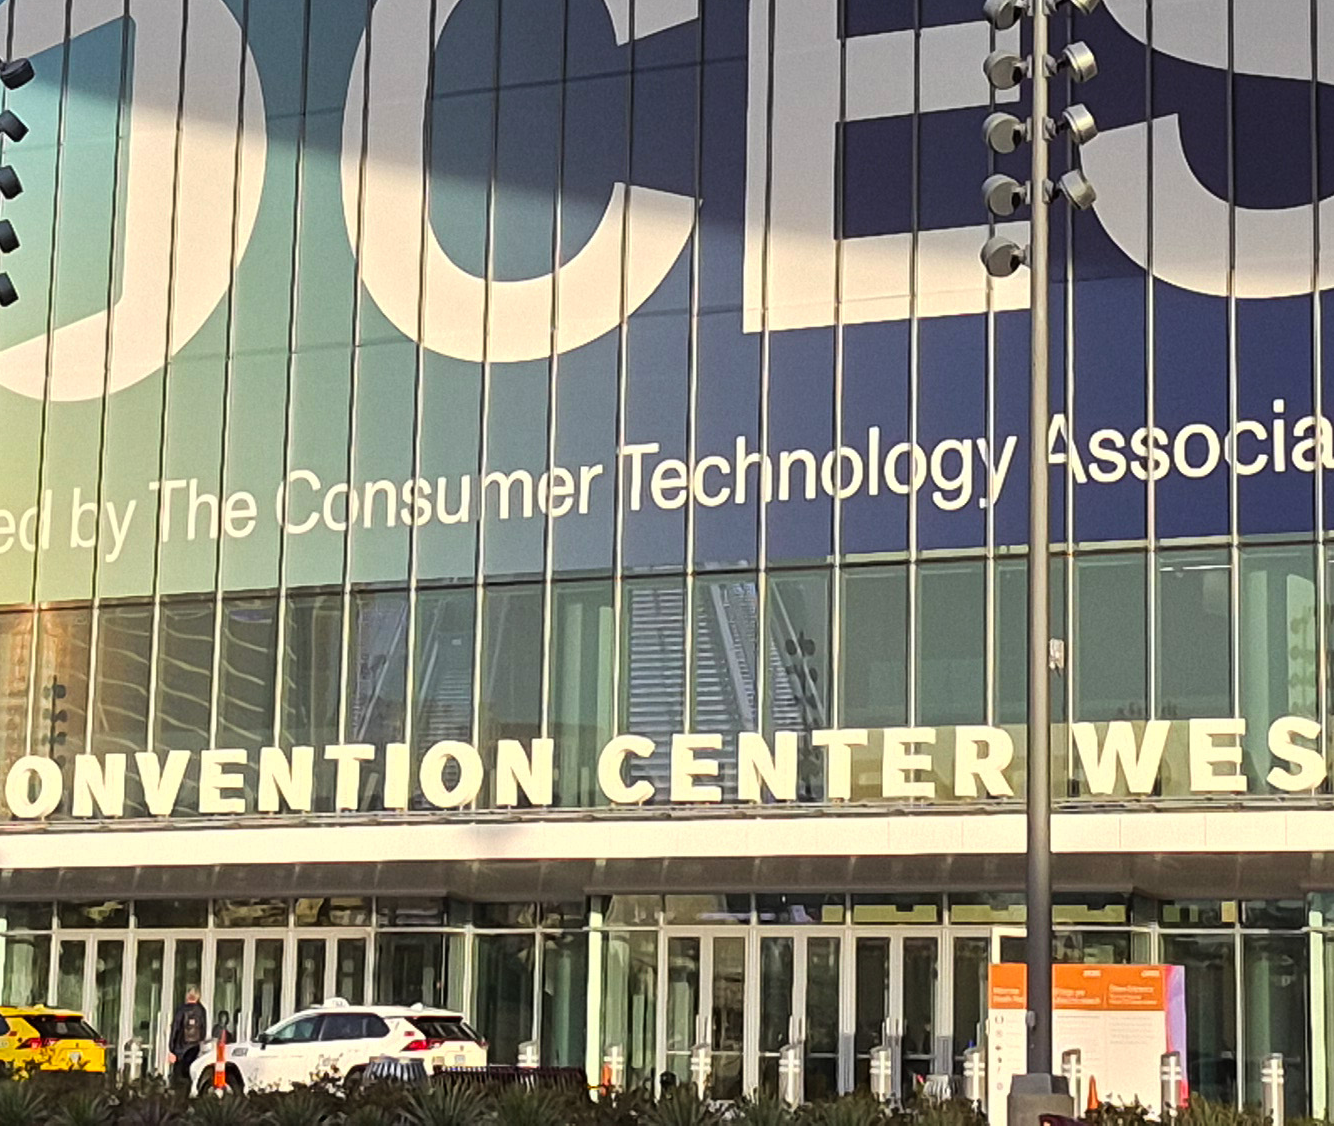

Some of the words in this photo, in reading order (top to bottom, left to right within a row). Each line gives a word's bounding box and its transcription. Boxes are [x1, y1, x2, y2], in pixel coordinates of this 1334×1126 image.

[70, 487, 137, 564] by
[149, 478, 258, 543] The
[275, 464, 604, 535] Consumer
[616, 426, 1018, 512] Technology
[597, 725, 1015, 805] CENTER
